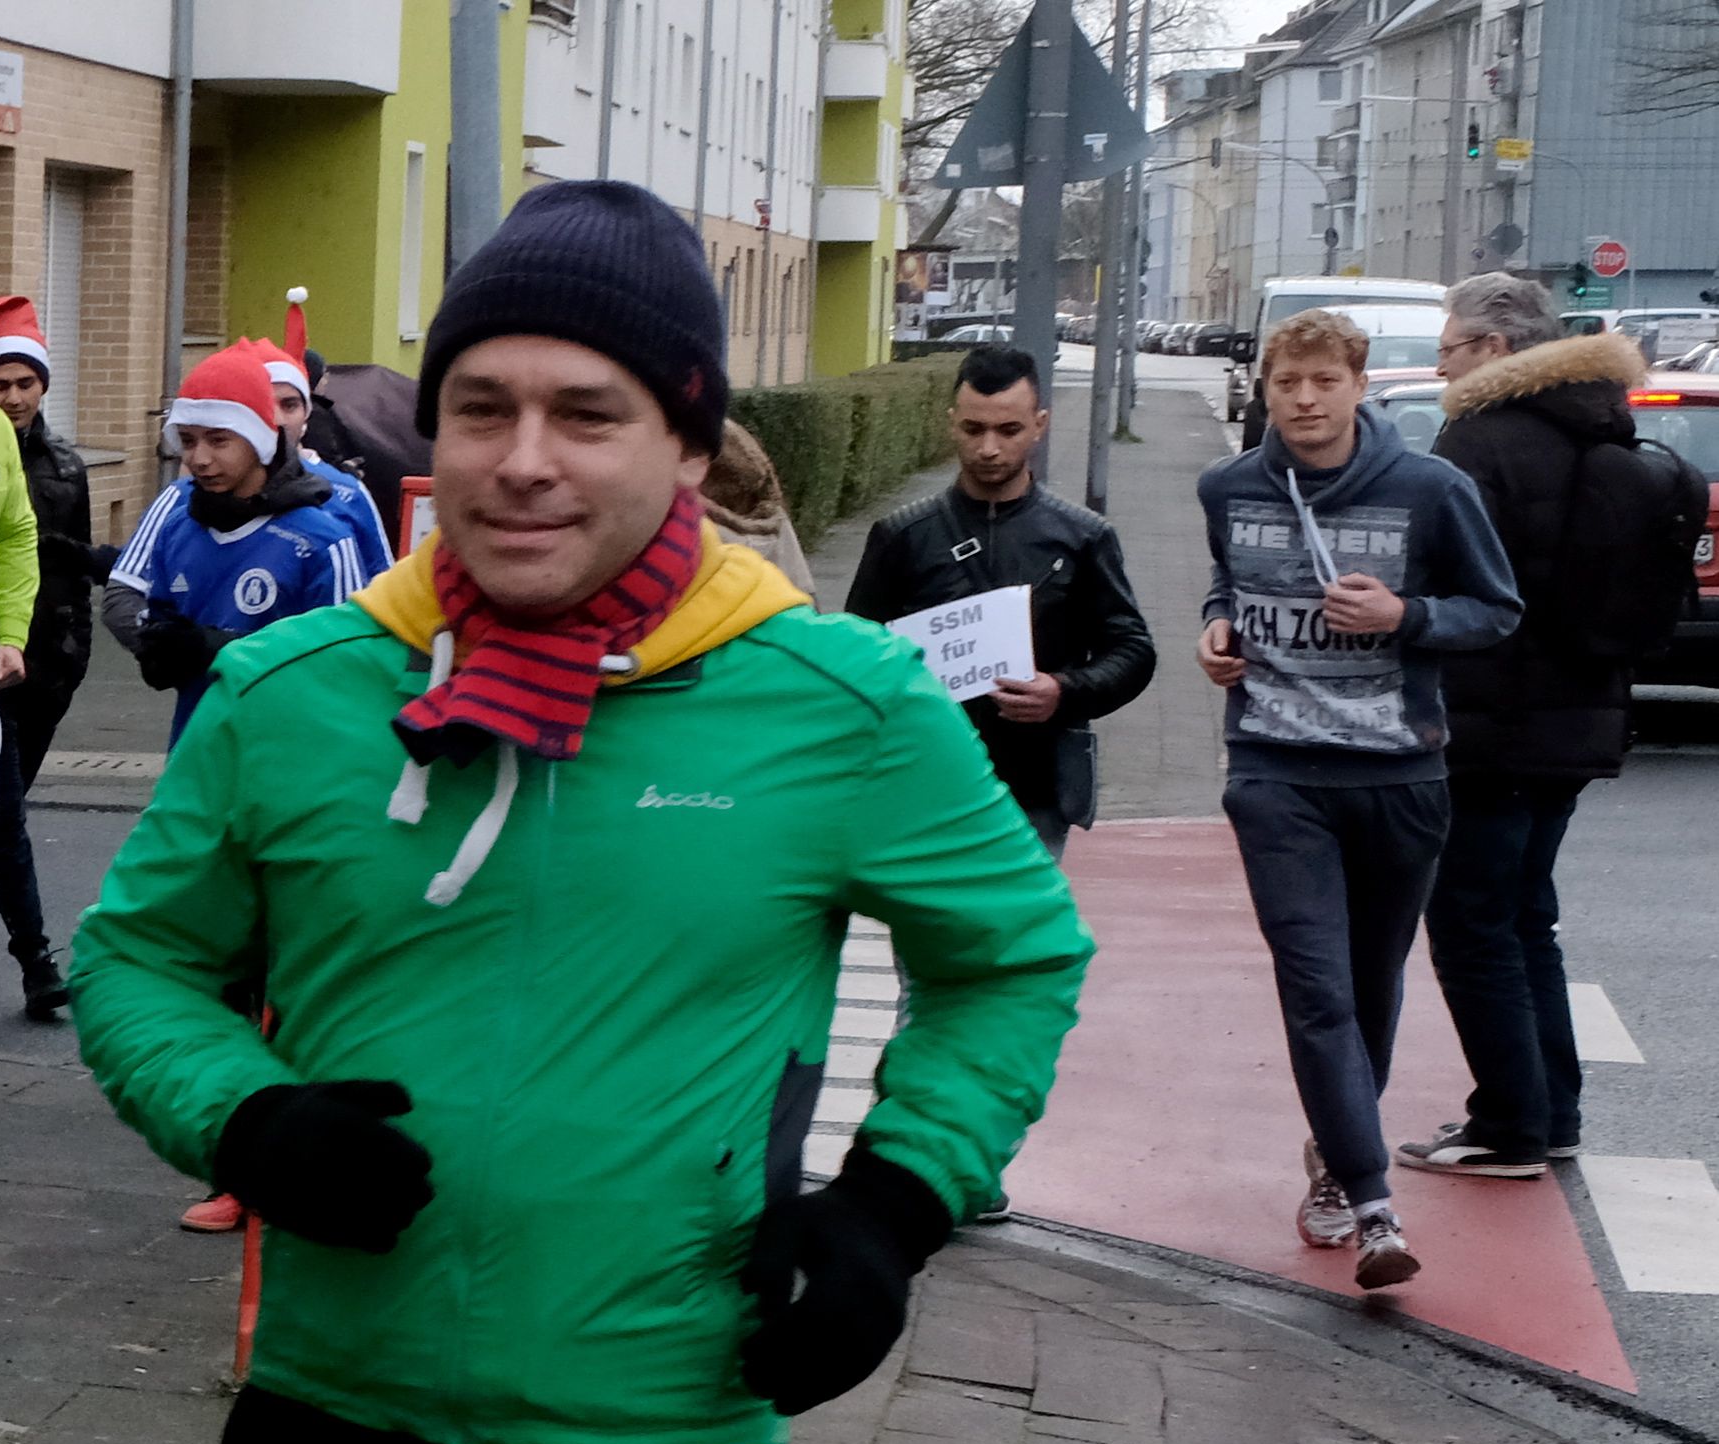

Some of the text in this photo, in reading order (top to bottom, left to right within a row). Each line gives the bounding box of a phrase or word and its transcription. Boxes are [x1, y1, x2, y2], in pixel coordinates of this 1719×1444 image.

[1593, 251, 1625, 266] STOP
[1231, 522, 1290, 549] HE
[929, 604, 983, 635] SSM
[940, 638, 977, 661] für
